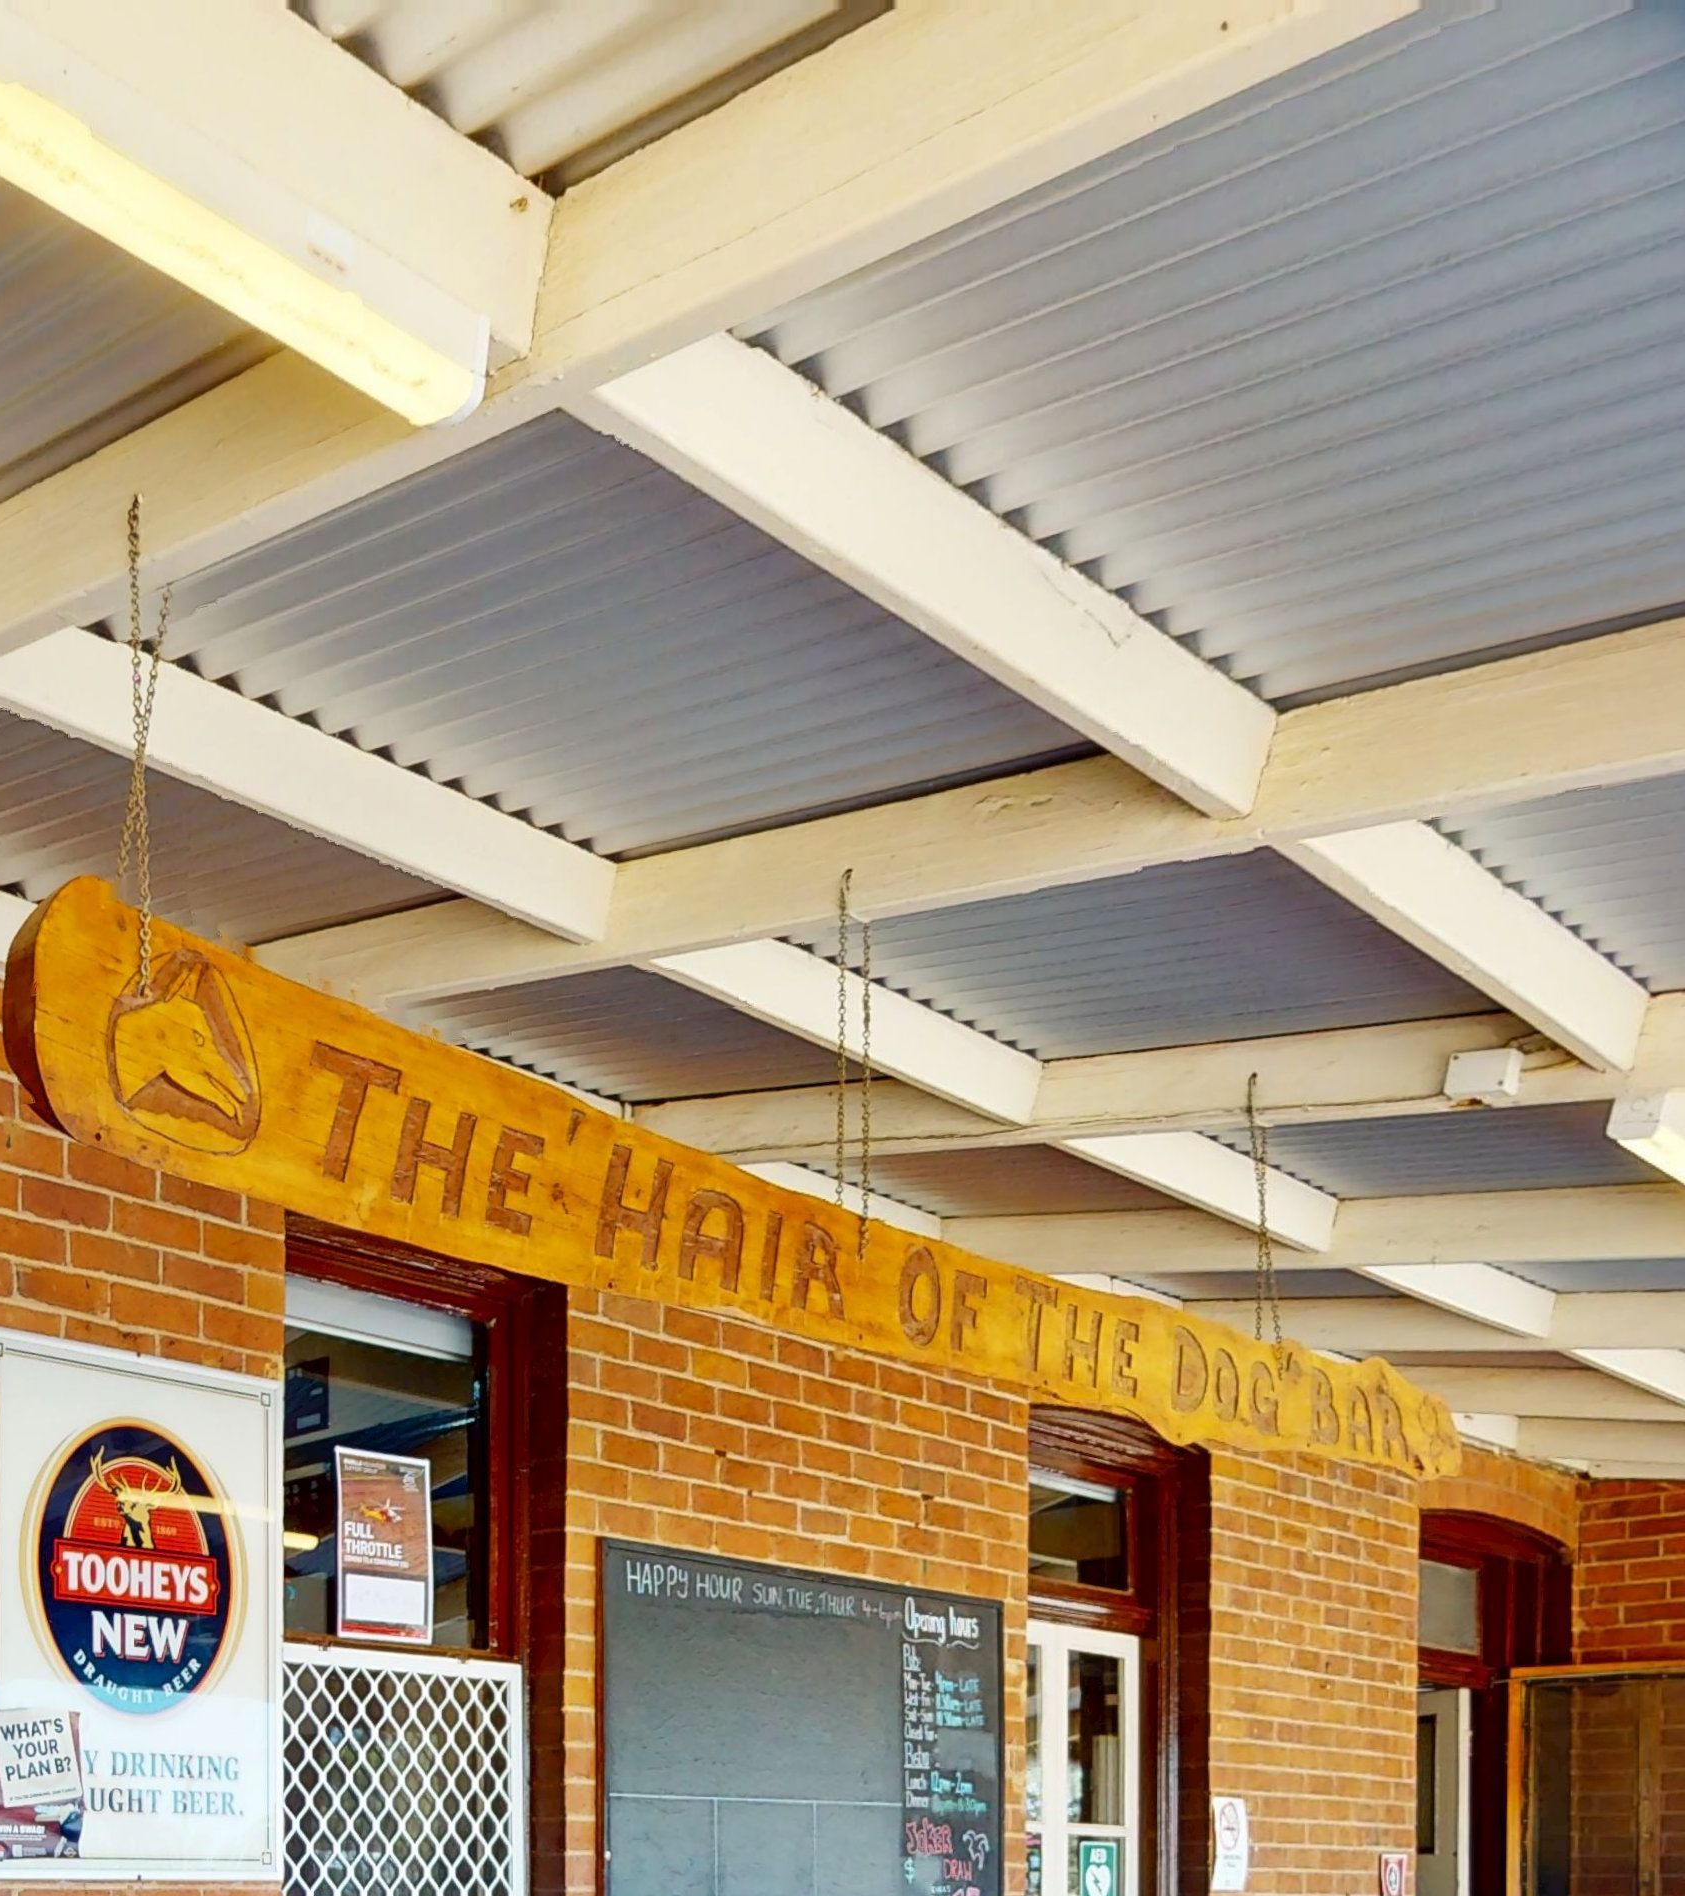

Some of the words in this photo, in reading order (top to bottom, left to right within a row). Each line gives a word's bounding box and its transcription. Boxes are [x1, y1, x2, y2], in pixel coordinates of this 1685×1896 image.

[311, 1038, 546, 1236] THE
[897, 1245, 988, 1353] OF
[1014, 1275, 1141, 1401] THE
[1311, 1366, 1411, 1463] BAR
[344, 1521, 375, 1540] FULL
[344, 1538, 403, 1560] THROTTLE
[62, 1551, 209, 1605] TOOHEYS
[625, 1560, 689, 1599] HAPPY
[695, 1572, 744, 1601] HOUR
[818, 1592, 857, 1617] THUR
[904, 1596, 947, 1644] Opening
[949, 1606, 980, 1639] hours
[91, 1610, 189, 1663] NEW
[73, 1648, 155, 1704] DRAUGHT
[163, 1656, 203, 1697] BEER
[0, 1719, 64, 1741] WHAT'S
[13, 1739, 59, 1760] YOUR
[5, 1758, 51, 1782] PLAN
[54, 1757, 72, 1774] B?
[111, 1751, 240, 1780] DRINKING
[87, 1787, 162, 1814] UGHT
[172, 1790, 244, 1816] BEER.
[13, 1825, 19, 1834] A
[905, 1816, 954, 1856] JOKER
[943, 1858, 973, 1881] DRAW
